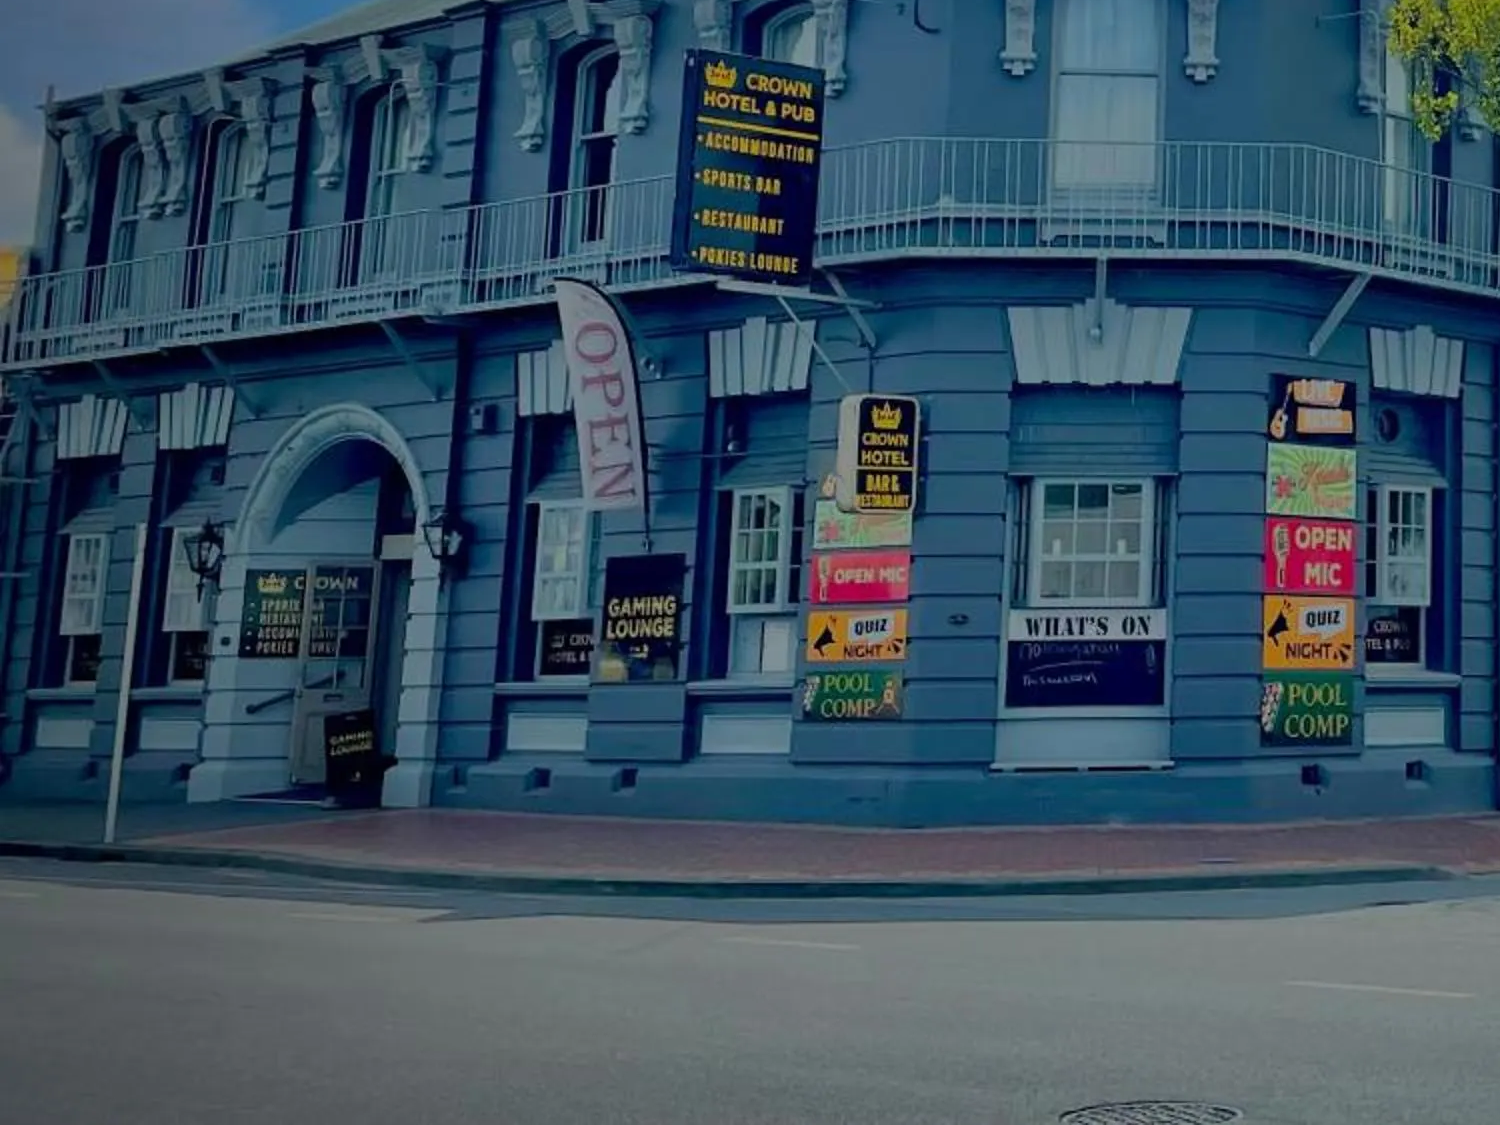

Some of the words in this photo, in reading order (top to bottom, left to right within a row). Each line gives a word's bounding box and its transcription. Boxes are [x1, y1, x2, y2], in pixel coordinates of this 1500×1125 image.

[746, 73, 813, 100] CROWN
[704, 90, 760, 114] HOTEL
[765, 100, 777, 117] &
[781, 102, 816, 123] PUB
[705, 131, 815, 164] ACCOMMODATION
[702, 169, 751, 191] SPORTS
[756, 176, 782, 195] BAR
[702, 209, 784, 236] RESTAURANT
[700, 246, 745, 268] POKIES
[751, 252, 799, 275] LOUNGE
[575, 321, 637, 498] OPEN
[862, 432, 909, 448] CROWN
[861, 450, 909, 465] HOTEL
[866, 474, 890, 492] BAR
[1295, 525, 1353, 551] OPEN
[293, 576, 359, 590] COWN
[834, 567, 875, 583] OPEN
[879, 566, 906, 583] MIC
[1304, 561, 1342, 586] MIC
[608, 595, 677, 617] GAMING
[606, 617, 675, 640] LOUNGE
[854, 618, 888, 636] QUIZ
[1026, 617, 1109, 636] WHAT'S
[1121, 616, 1151, 636] ON
[1306, 610, 1341, 628] QUIZ
[843, 643, 883, 659] NIGHT
[1285, 642, 1332, 659] NIGHT
[823, 673, 874, 694] POOL
[1288, 683, 1347, 707] POOL
[820, 698, 877, 718] COMP
[1284, 714, 1349, 738] COMP
